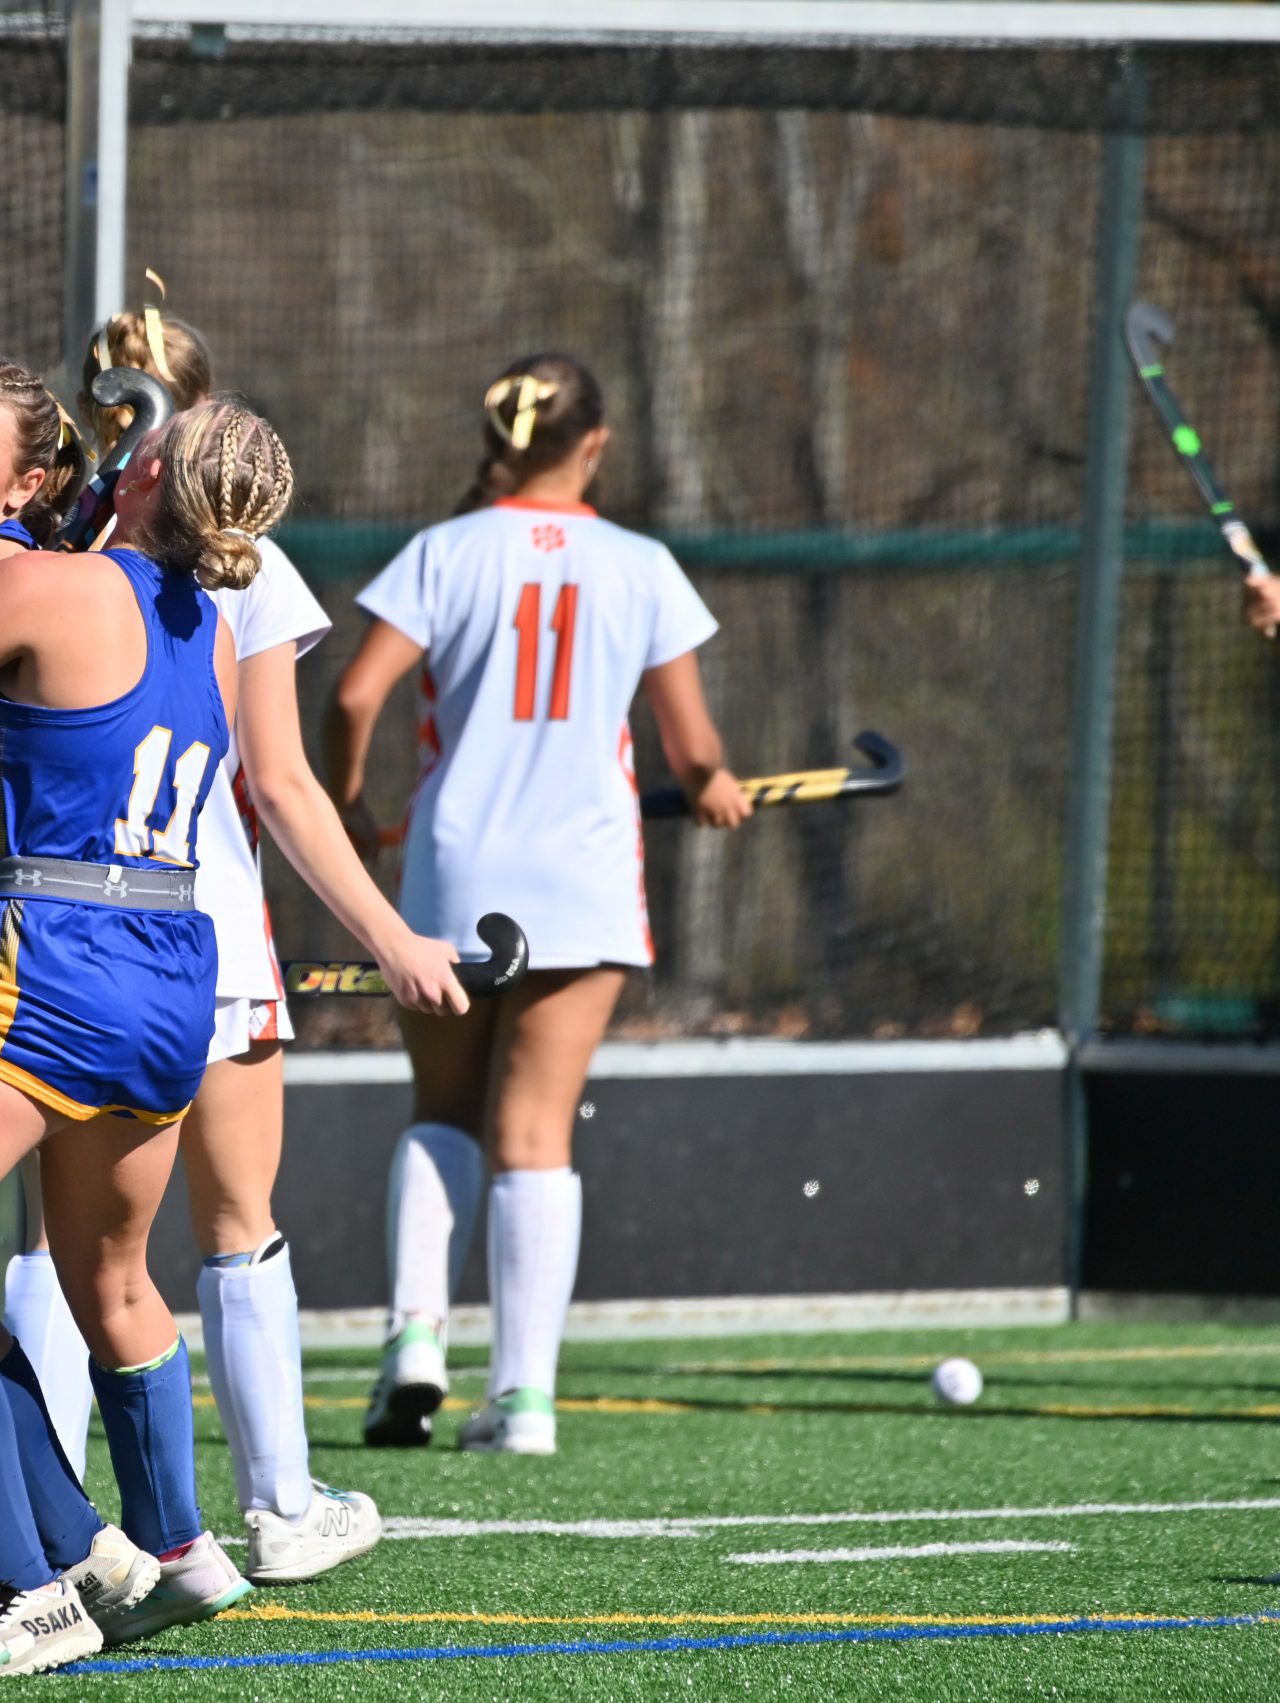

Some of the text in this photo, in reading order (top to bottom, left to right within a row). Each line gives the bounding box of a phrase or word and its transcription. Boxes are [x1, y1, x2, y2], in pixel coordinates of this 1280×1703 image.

[512, 582, 579, 721] 11
[114, 725, 211, 868] 11
[20, 1602, 83, 1637] OSAKA
